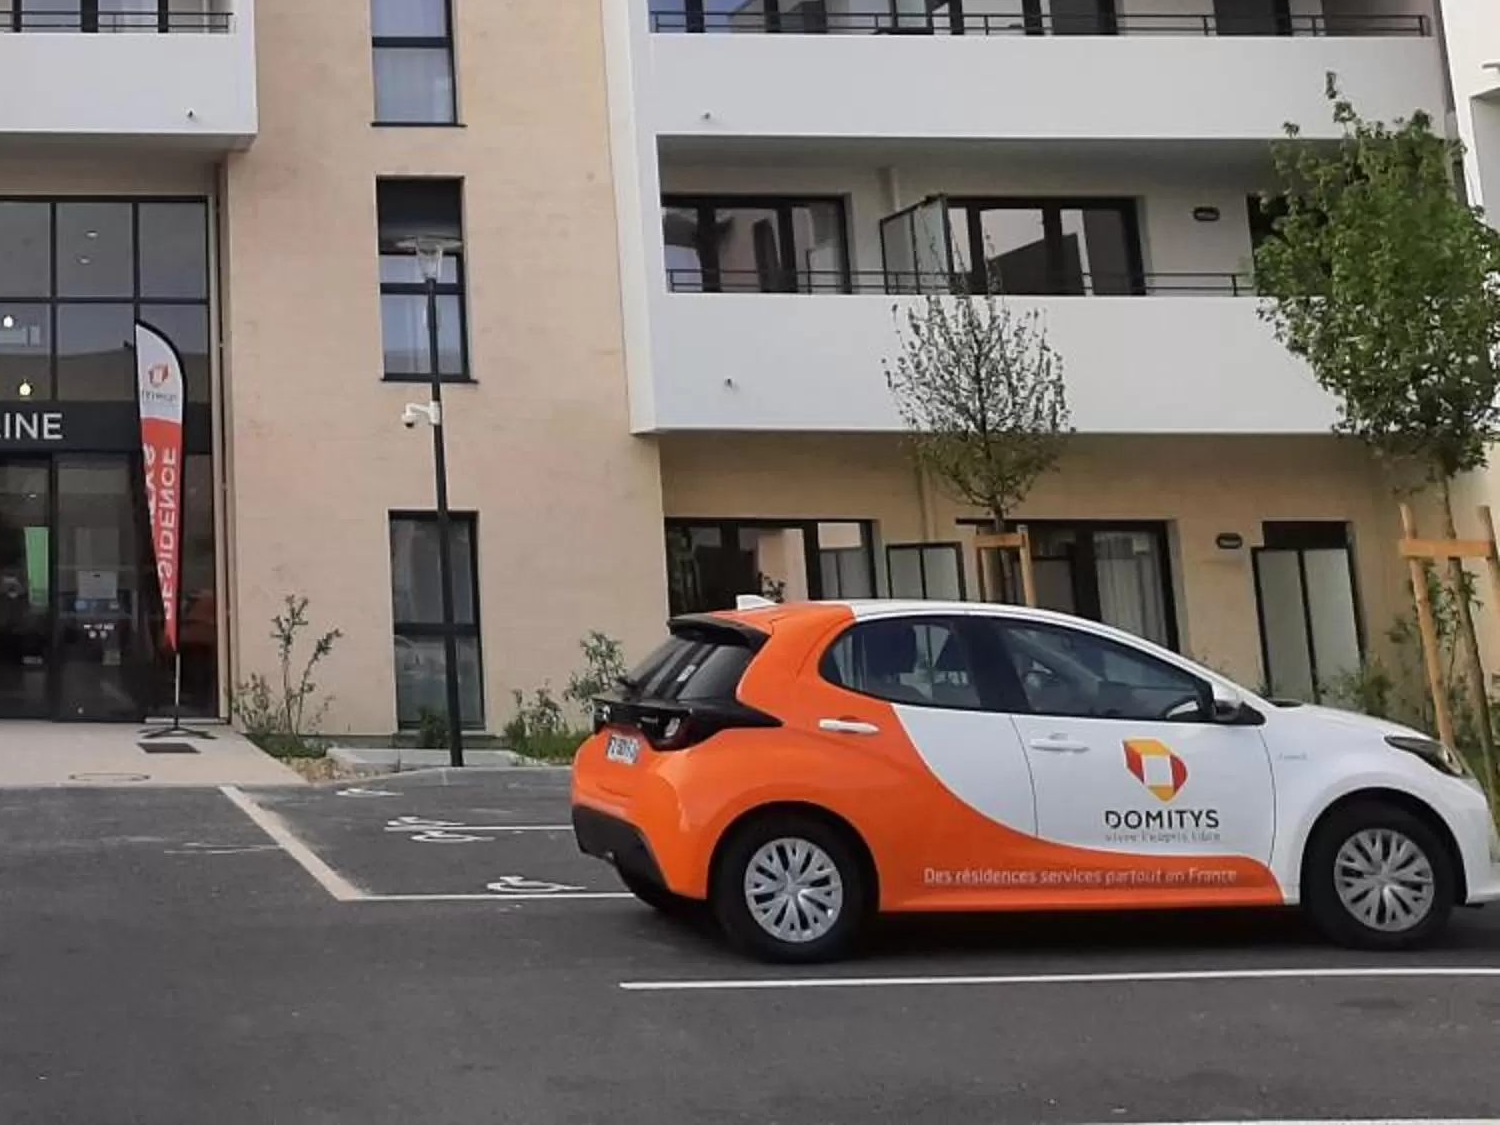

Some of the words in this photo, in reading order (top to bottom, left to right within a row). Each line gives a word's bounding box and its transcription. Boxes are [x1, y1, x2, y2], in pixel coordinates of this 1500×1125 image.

[1104, 809, 1220, 830] DOMITYS
[923, 866, 951, 884] Des
[1041, 867, 1101, 884] services
